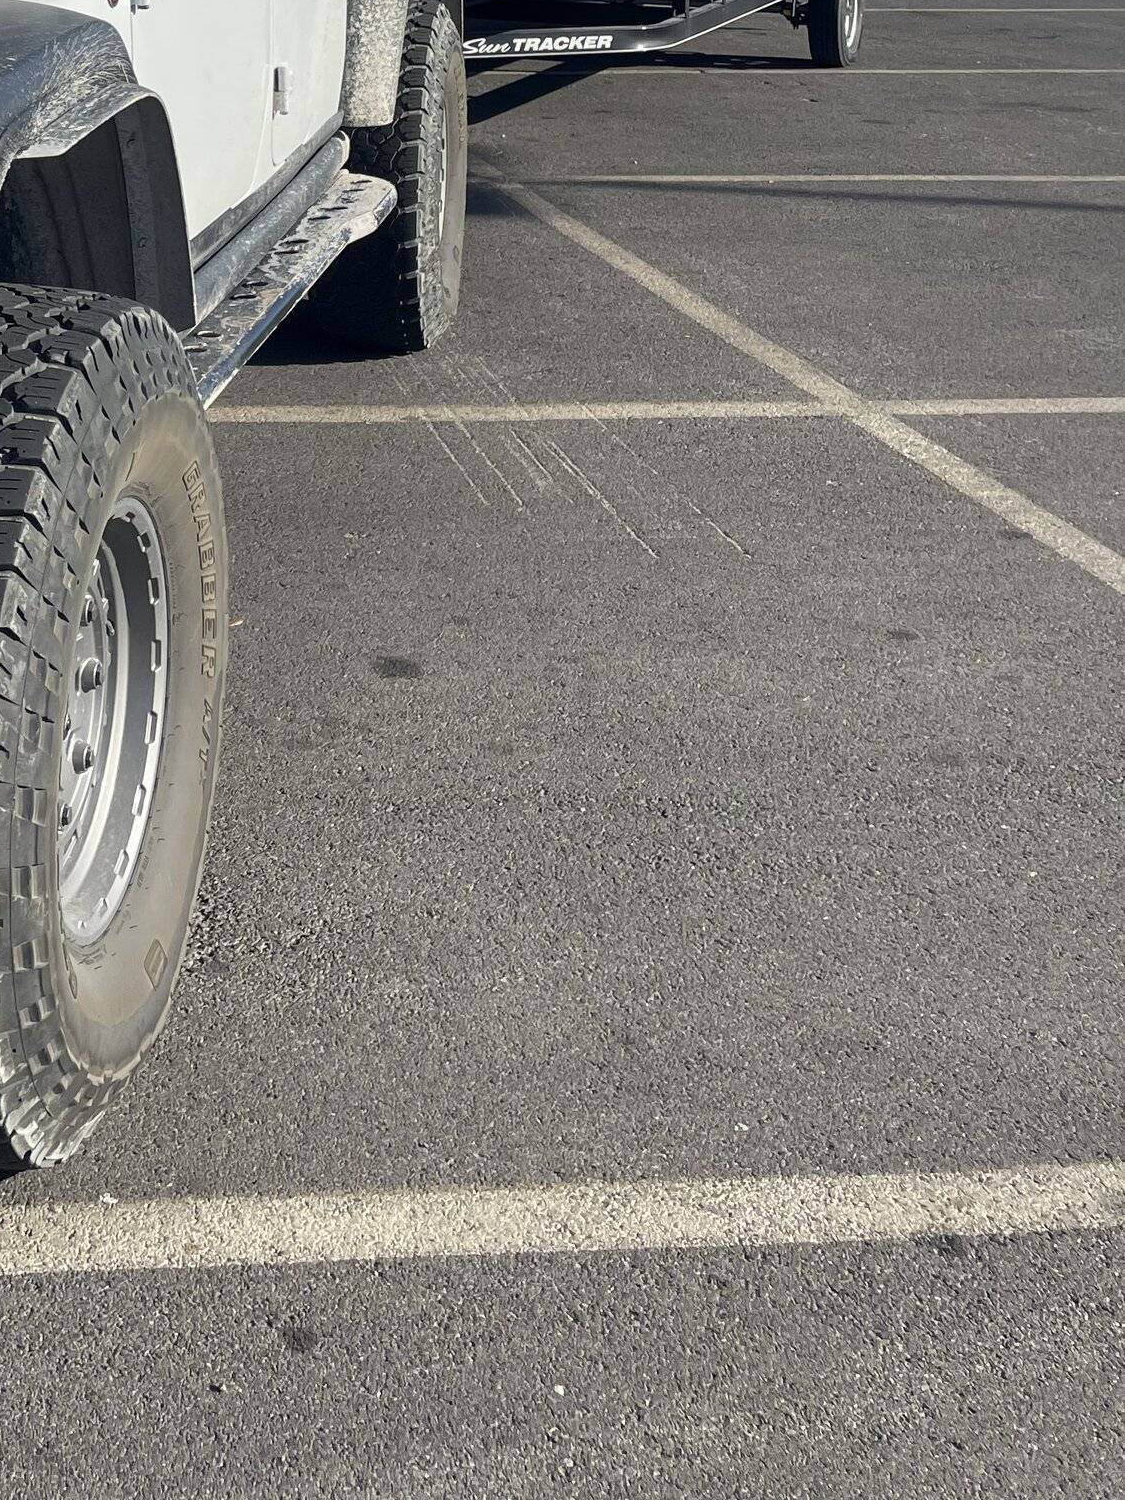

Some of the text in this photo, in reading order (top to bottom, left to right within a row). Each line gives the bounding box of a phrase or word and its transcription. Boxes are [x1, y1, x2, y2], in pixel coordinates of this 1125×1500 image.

[463, 35, 613, 54] Sun TRACKER
[182, 459, 218, 679] GRABBER
